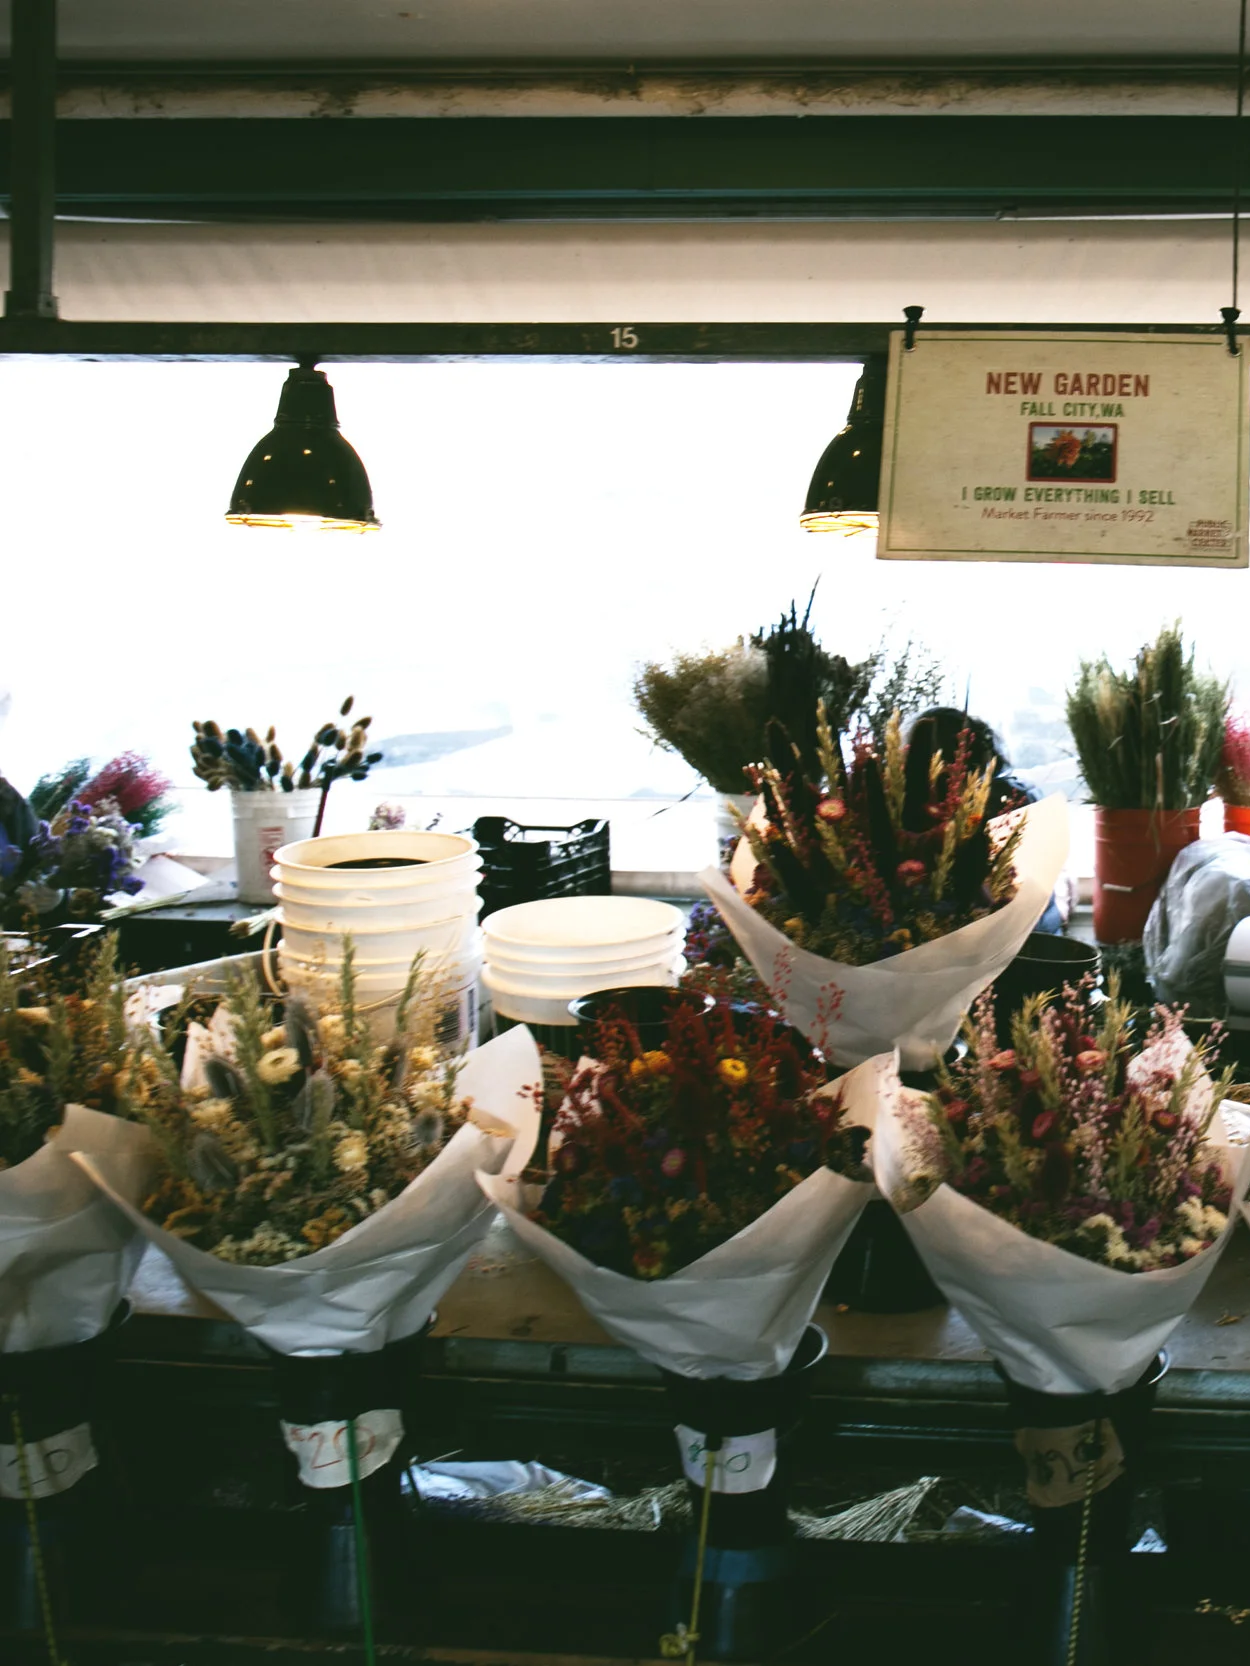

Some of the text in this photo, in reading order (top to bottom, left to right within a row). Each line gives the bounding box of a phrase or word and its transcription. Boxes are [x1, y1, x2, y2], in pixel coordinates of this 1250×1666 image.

[610, 326, 639, 349] 15
[986, 371, 1150, 397] NEW GARDEN
[1020, 401, 1056, 416] FALL
[961, 487, 1176, 505] I GROW EVERYTHING I SELL
[981, 507, 1155, 523] Market Farmer since 1992
